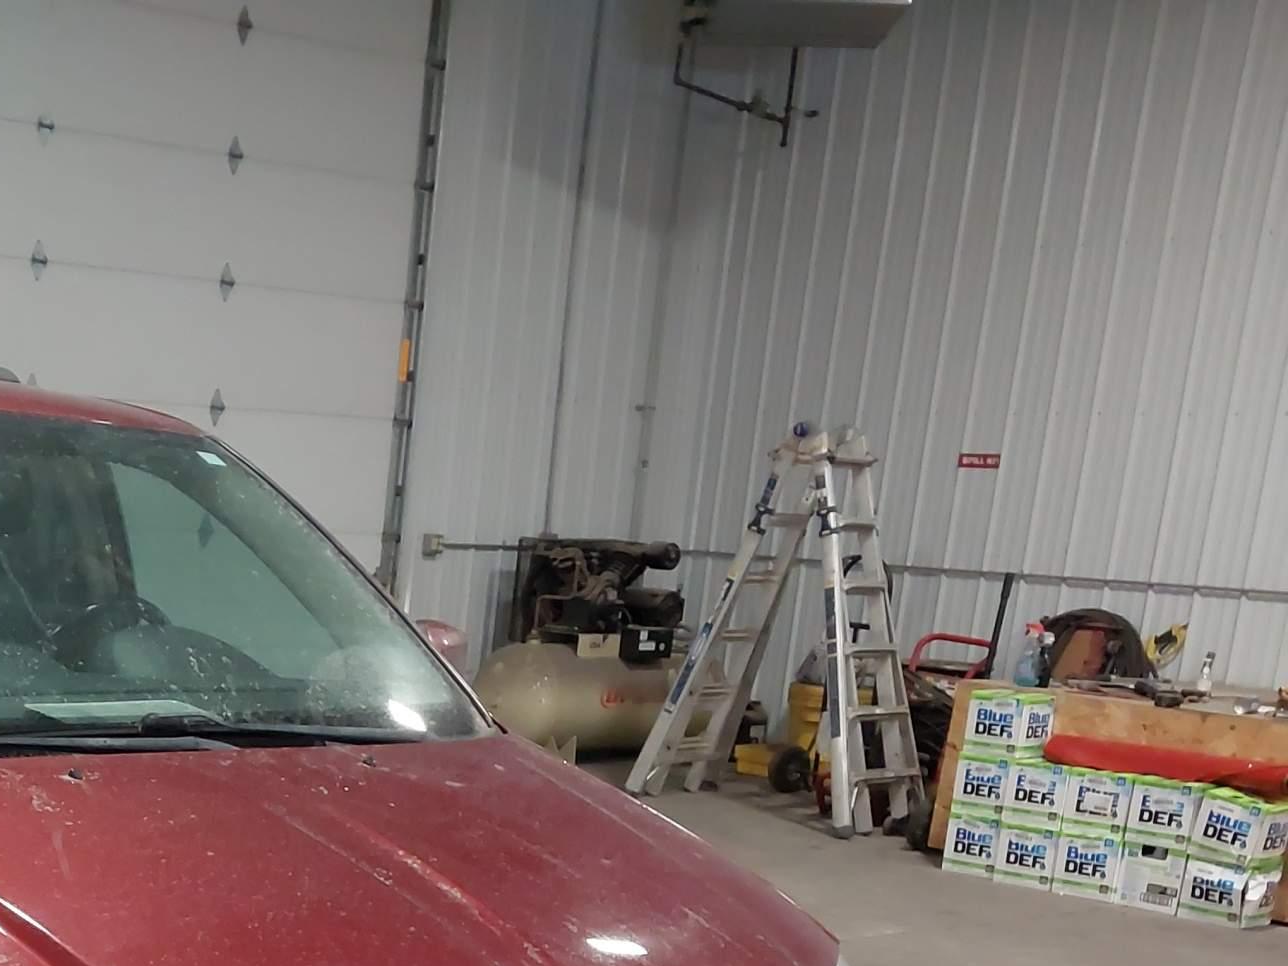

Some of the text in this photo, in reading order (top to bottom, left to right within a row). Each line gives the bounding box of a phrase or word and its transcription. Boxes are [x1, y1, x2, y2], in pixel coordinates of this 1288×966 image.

[977, 708, 1014, 724] Blue
[975, 721, 1013, 737] DEF
[963, 782, 1001, 798] DEF
[1014, 788, 1056, 805] DEF
[1138, 809, 1183, 827] DEF
[1208, 809, 1251, 833] Blue
[956, 827, 993, 844] Blue
[1203, 823, 1248, 846] DEF
[953, 840, 992, 857] DEF
[1067, 846, 1107, 863] Blue
[1005, 851, 1046, 869] DEF
[1064, 859, 1106, 877] DEF
[1191, 885, 1233, 905] DEF
